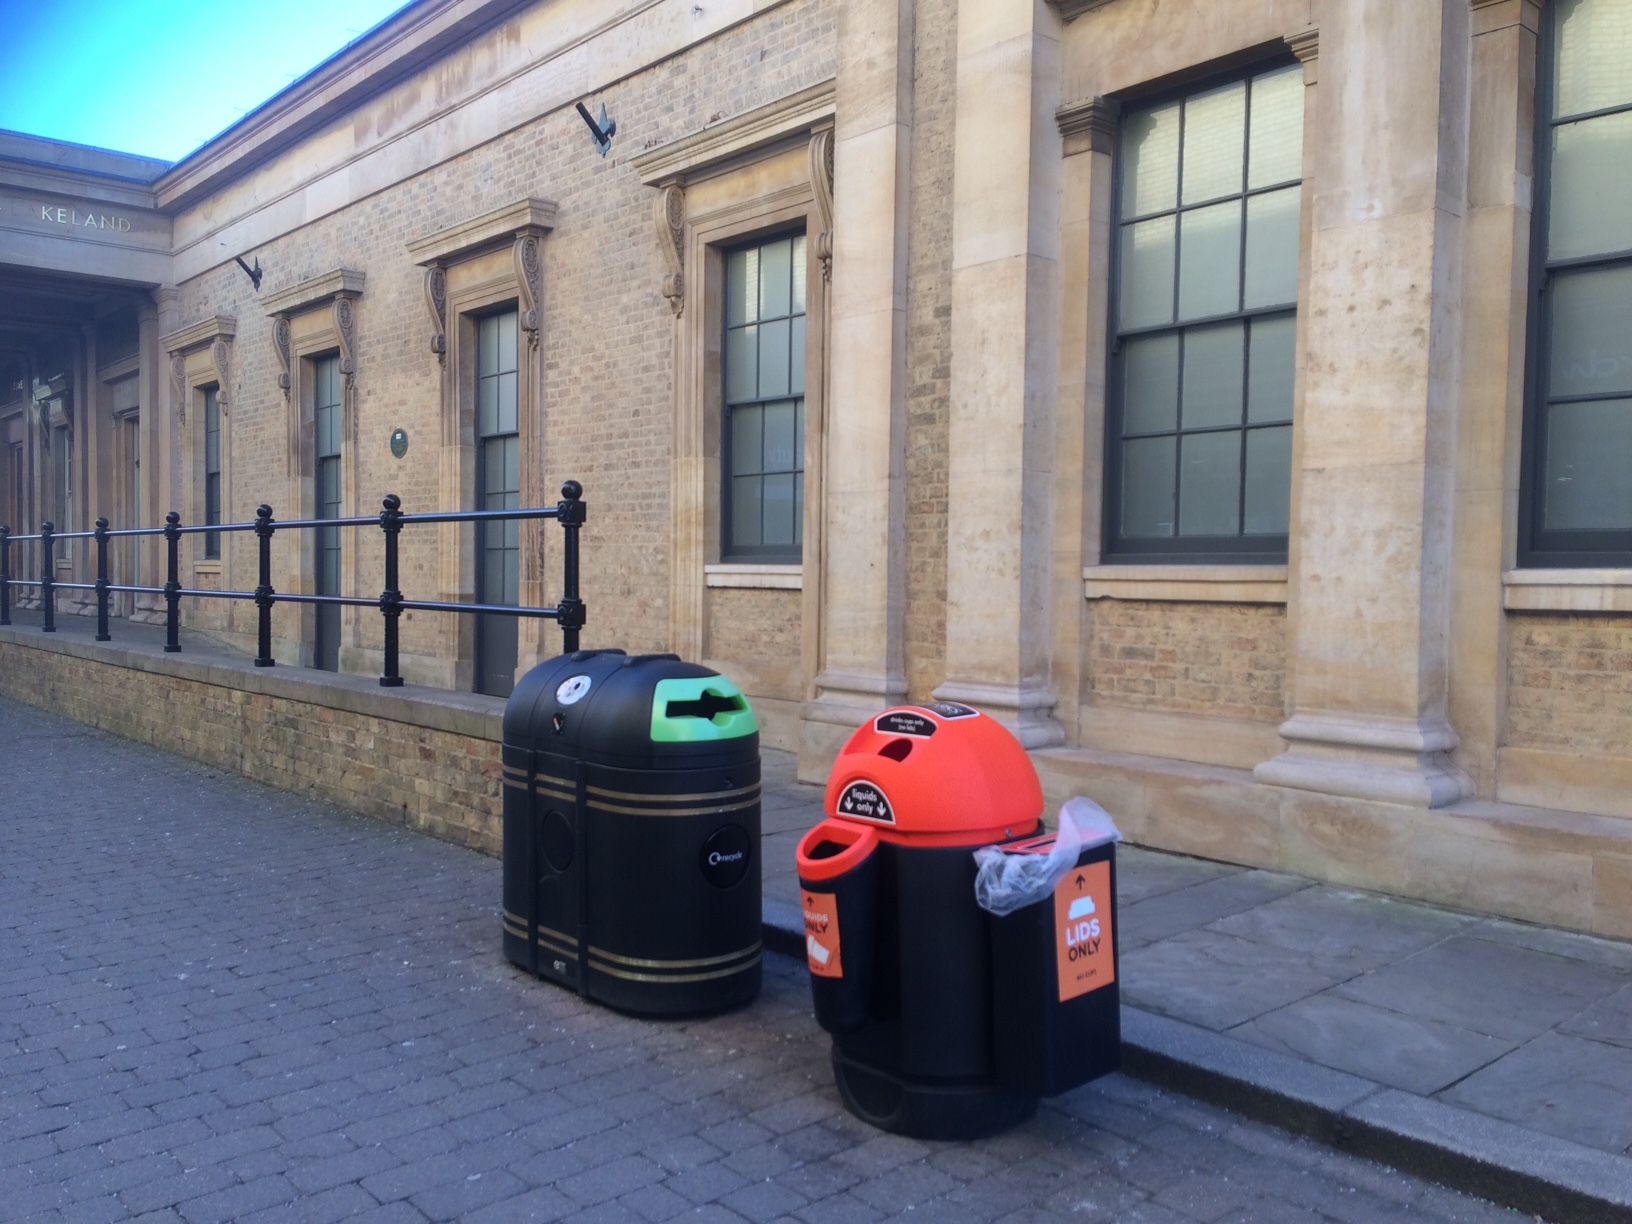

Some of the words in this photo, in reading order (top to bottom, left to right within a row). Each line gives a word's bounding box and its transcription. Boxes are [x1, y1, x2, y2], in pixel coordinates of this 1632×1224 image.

[41, 205, 131, 232] KELAND
[852, 788, 878, 802] liquids
[856, 802, 873, 815] only
[1066, 918, 1101, 946] LIDS
[1069, 938, 1101, 961] ONLY
